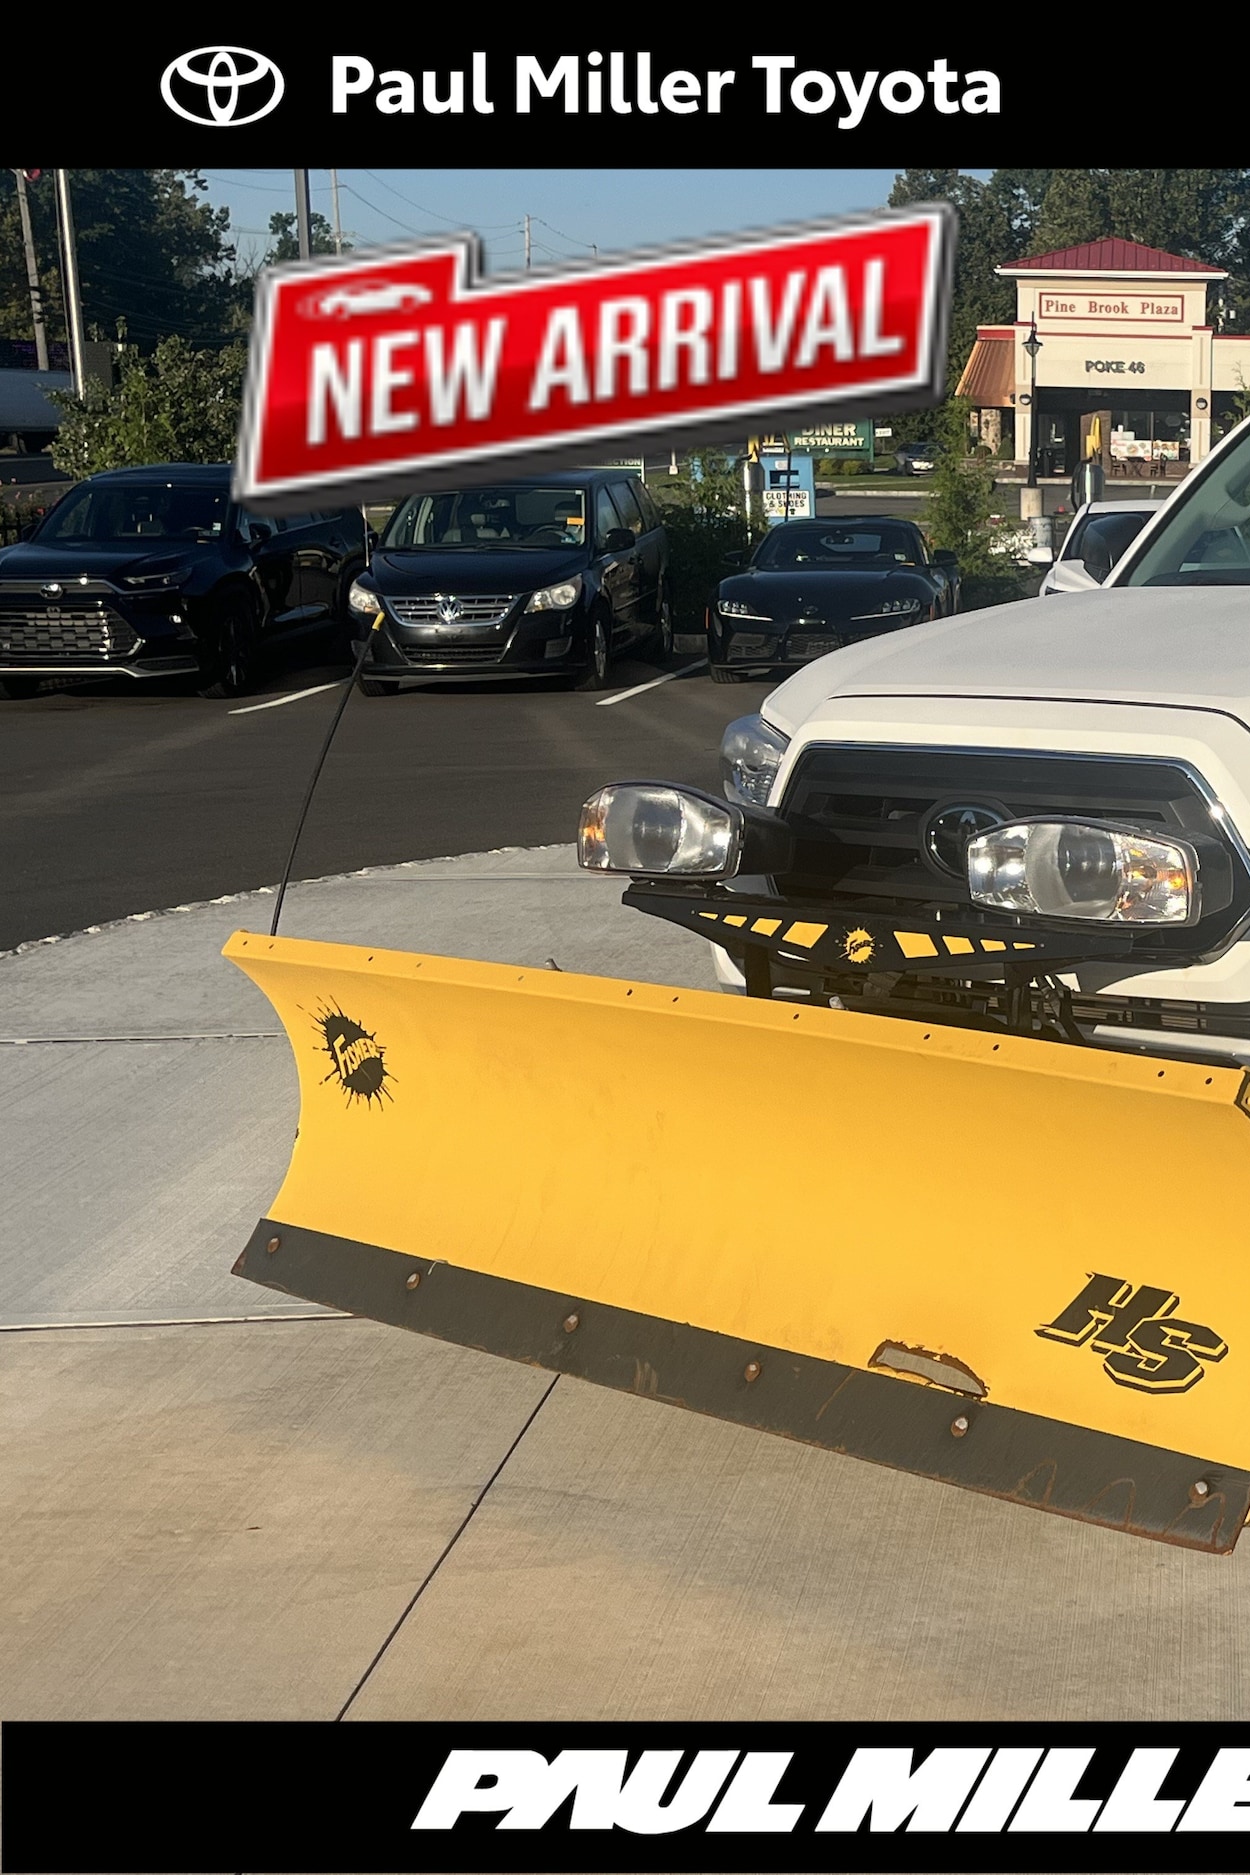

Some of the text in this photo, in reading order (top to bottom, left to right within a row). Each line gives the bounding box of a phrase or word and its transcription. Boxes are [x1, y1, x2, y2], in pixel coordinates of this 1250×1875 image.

[1045, 300, 1178, 315] Pine Brook Plaza
[1085, 360, 1125, 373] POKE
[802, 423, 856, 437] DINER
[794, 437, 864, 447] RESTAURANT
[1034, 1270, 1229, 1395] HS
